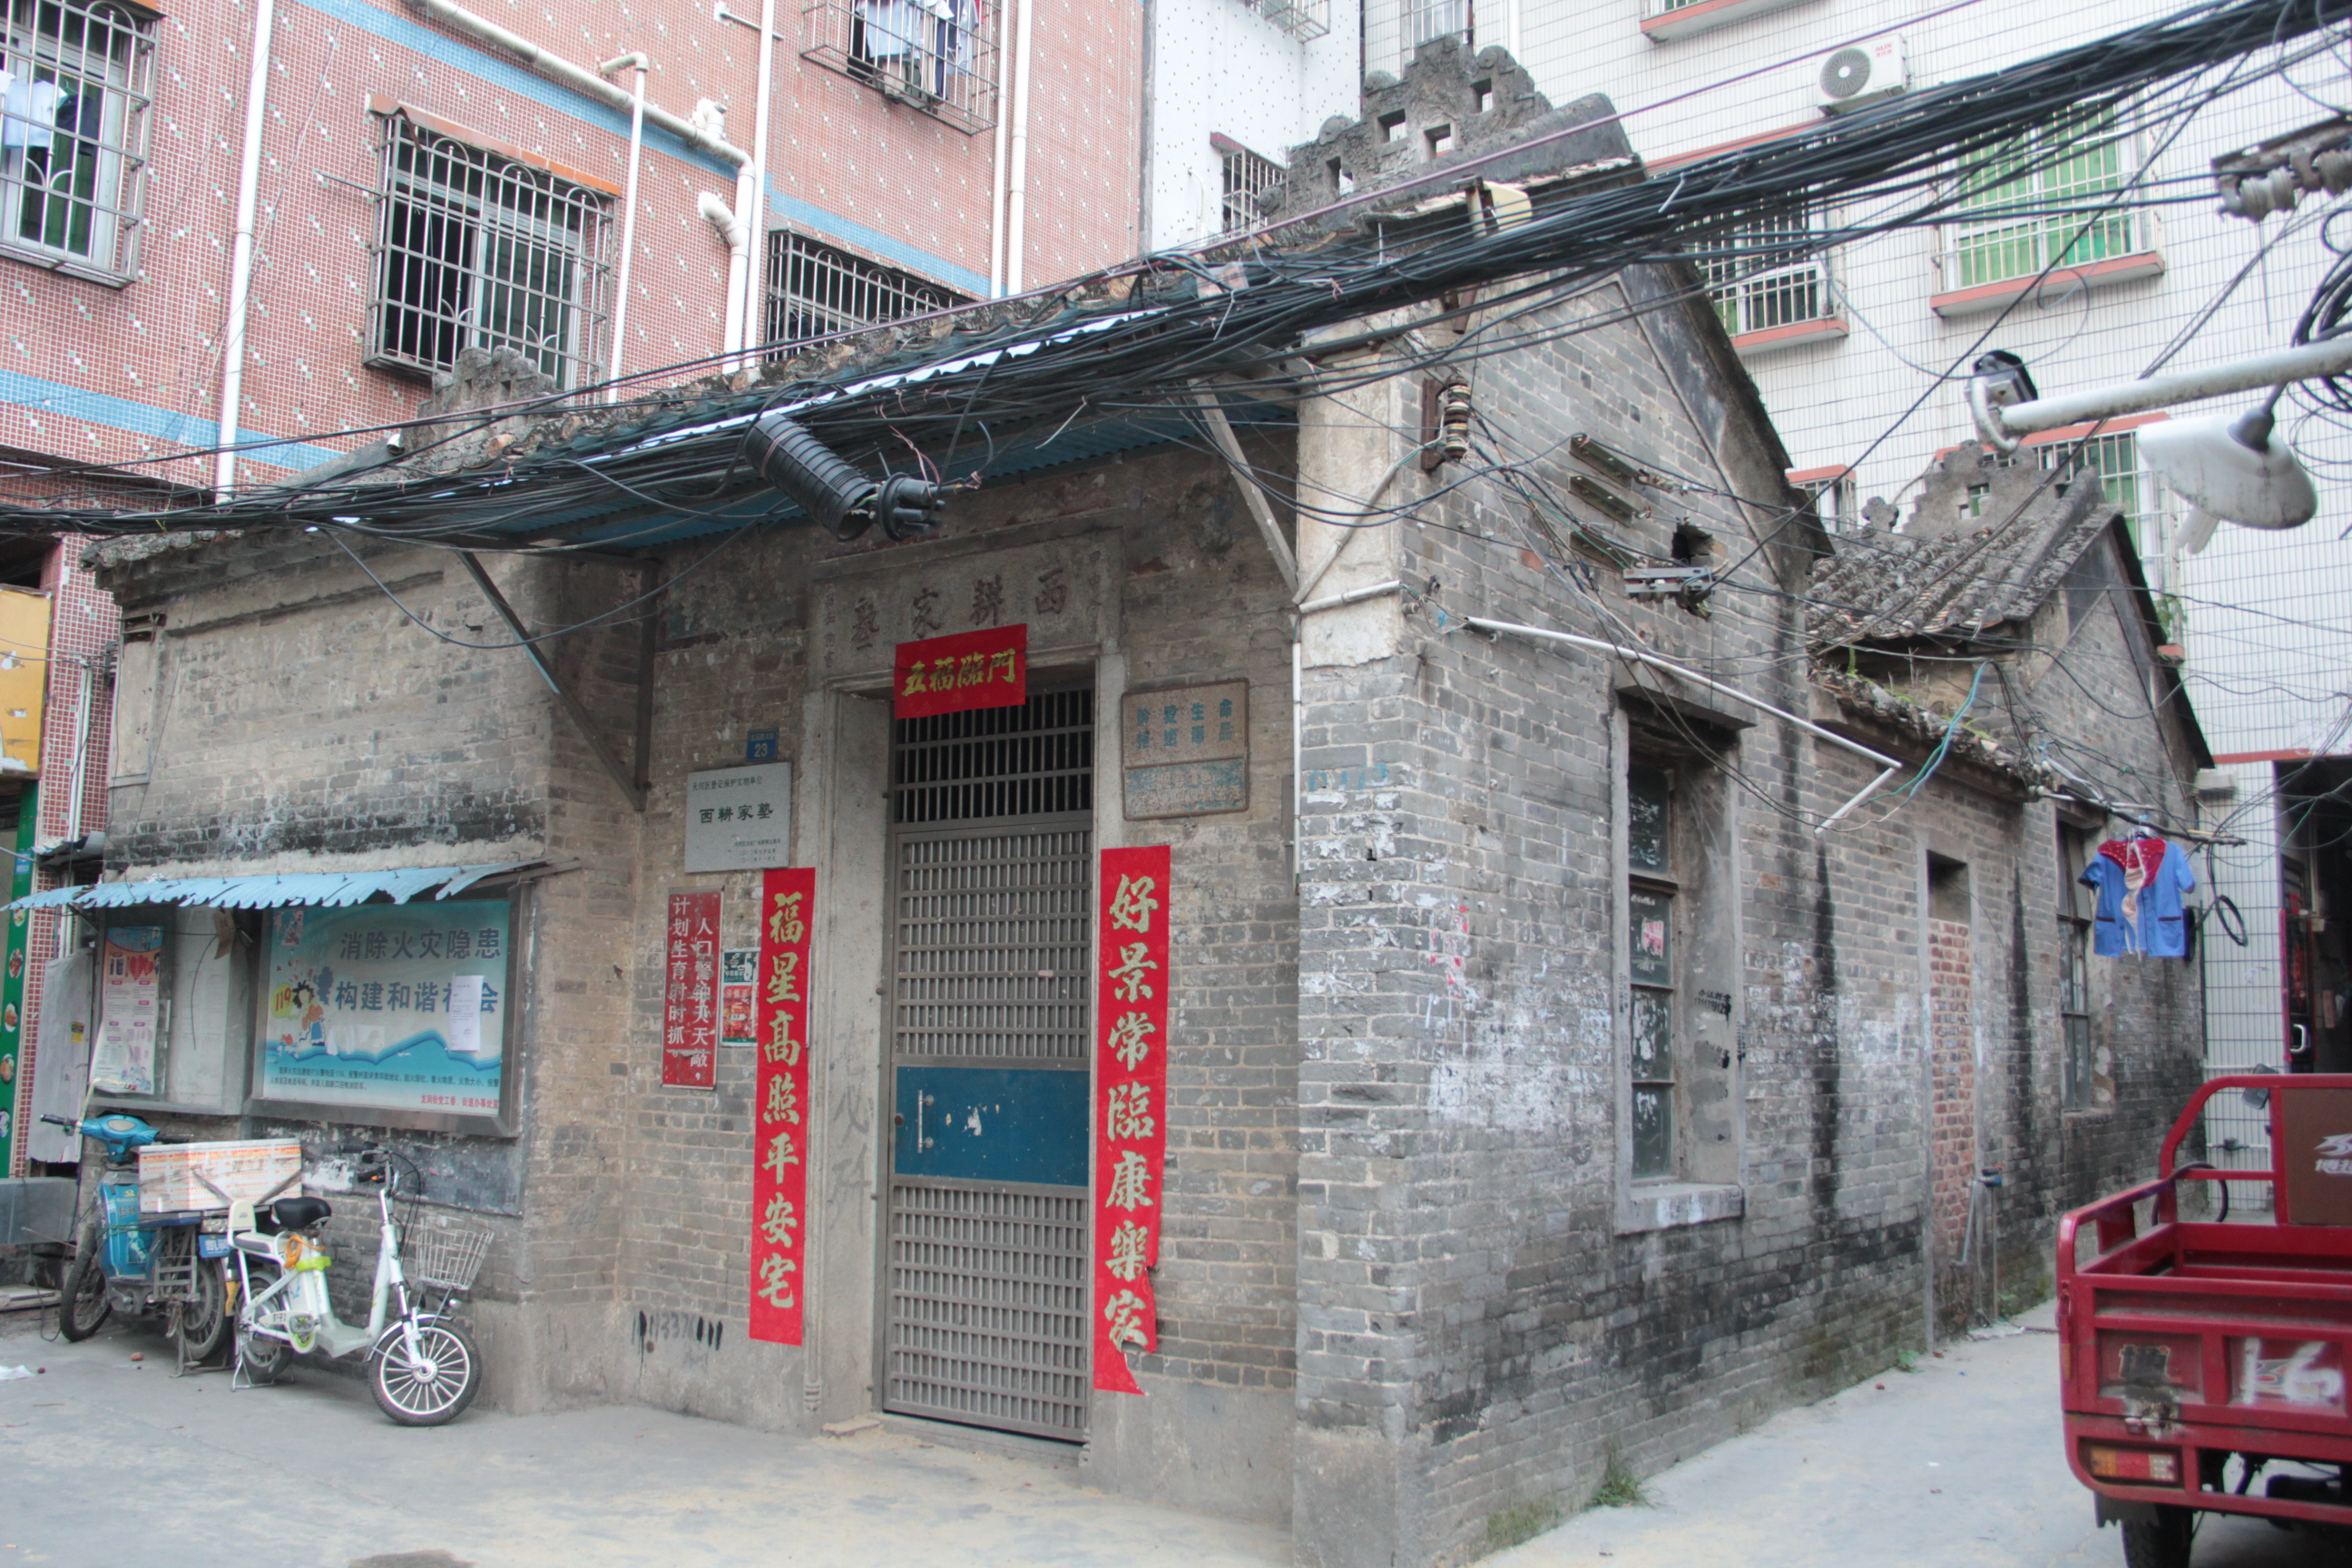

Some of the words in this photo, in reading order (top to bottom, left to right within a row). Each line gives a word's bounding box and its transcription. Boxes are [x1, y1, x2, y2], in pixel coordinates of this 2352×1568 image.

[901, 647, 1016, 696] 五福臨門
[754, 742, 769, 758] 23
[692, 775, 763, 791] 天河区登记保护文物单位
[699, 802, 774, 824] 西耕家塾
[339, 927, 502, 961] 消除火灾隐患
[274, 987, 292, 1012] 119
[758, 890, 806, 1309] 福星高照平安宅
